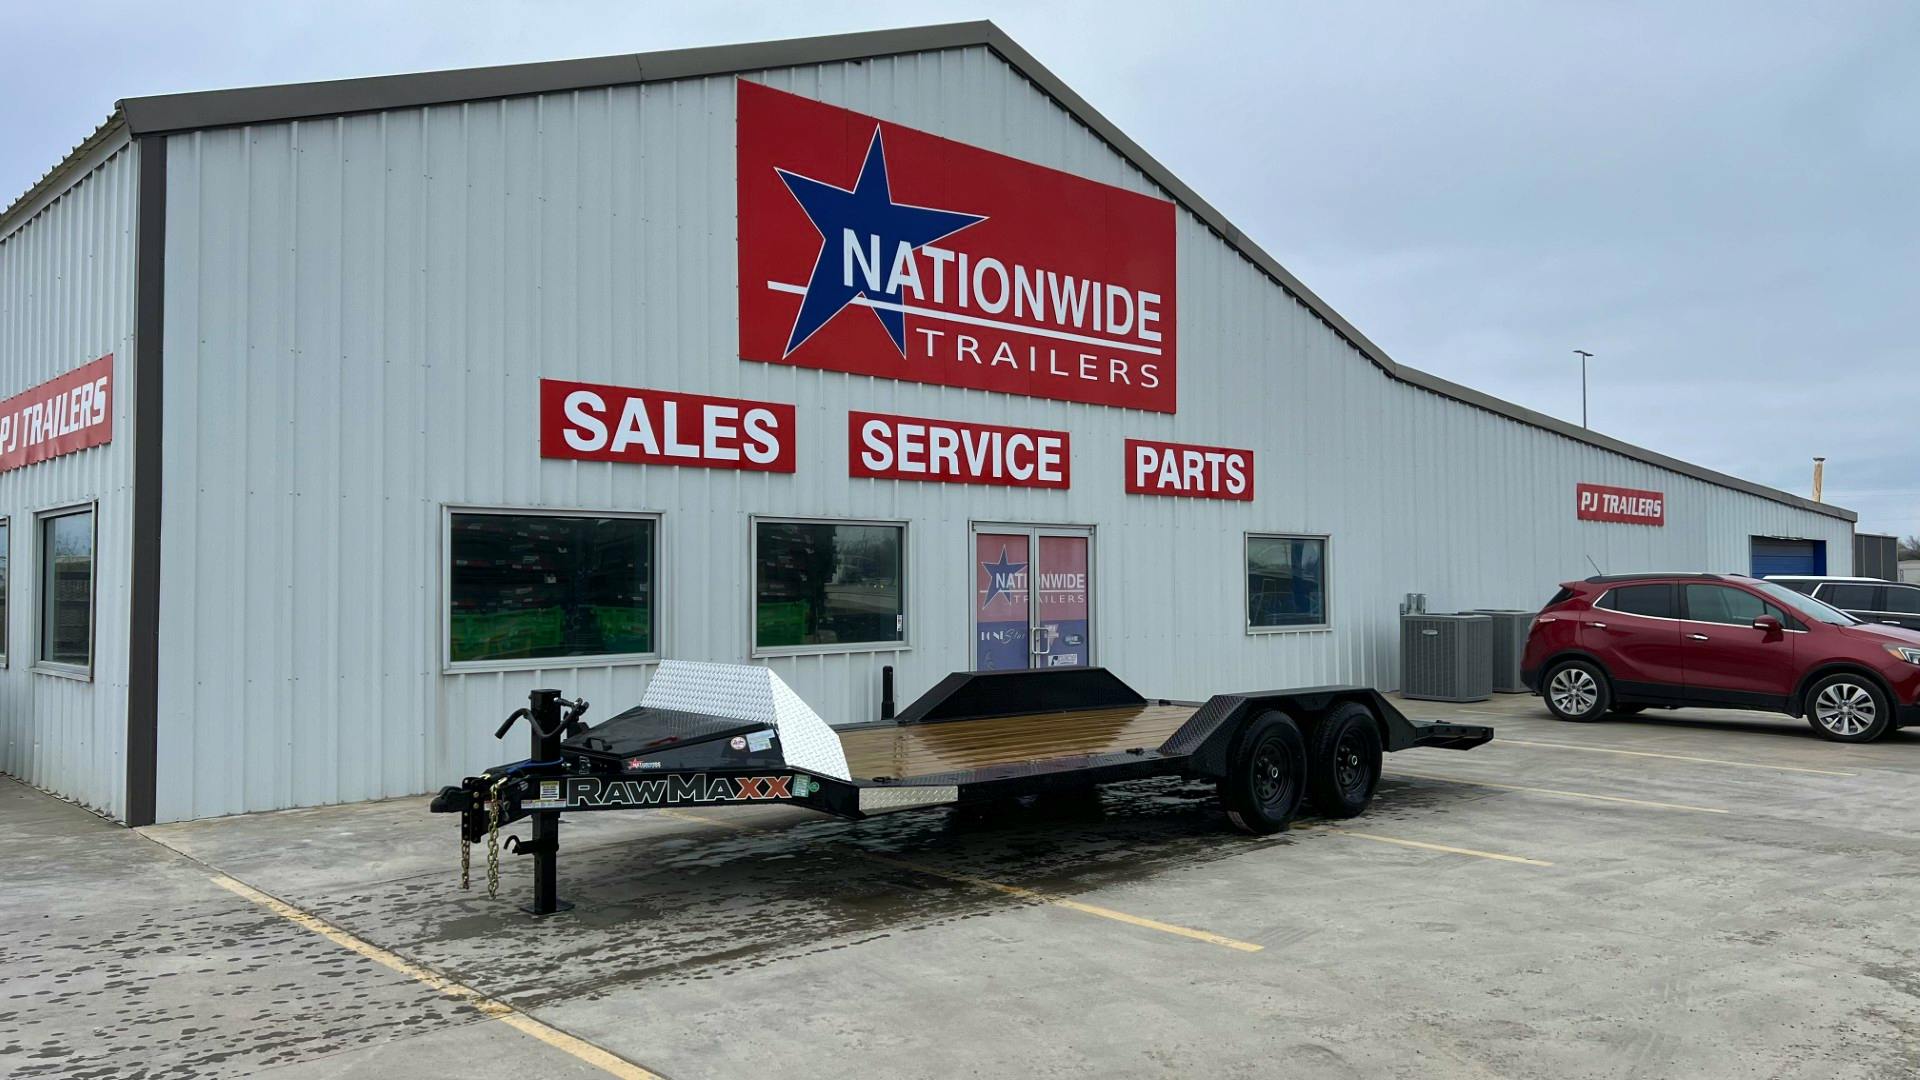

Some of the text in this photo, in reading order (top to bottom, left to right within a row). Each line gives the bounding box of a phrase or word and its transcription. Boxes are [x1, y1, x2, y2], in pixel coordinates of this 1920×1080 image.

[843, 228, 1162, 342] NATIONWIDE
[915, 328, 1160, 389] TRAILERS
[0, 376, 108, 456] PJ TRAILERS
[562, 390, 780, 464] SALES
[861, 419, 1062, 482] SERVICE
[1136, 446, 1246, 495] PARTS
[1581, 491, 1662, 518] PJ TRAILERS
[995, 573, 1085, 589] NATINWIDE
[566, 773, 793, 807] RAWMAXX
